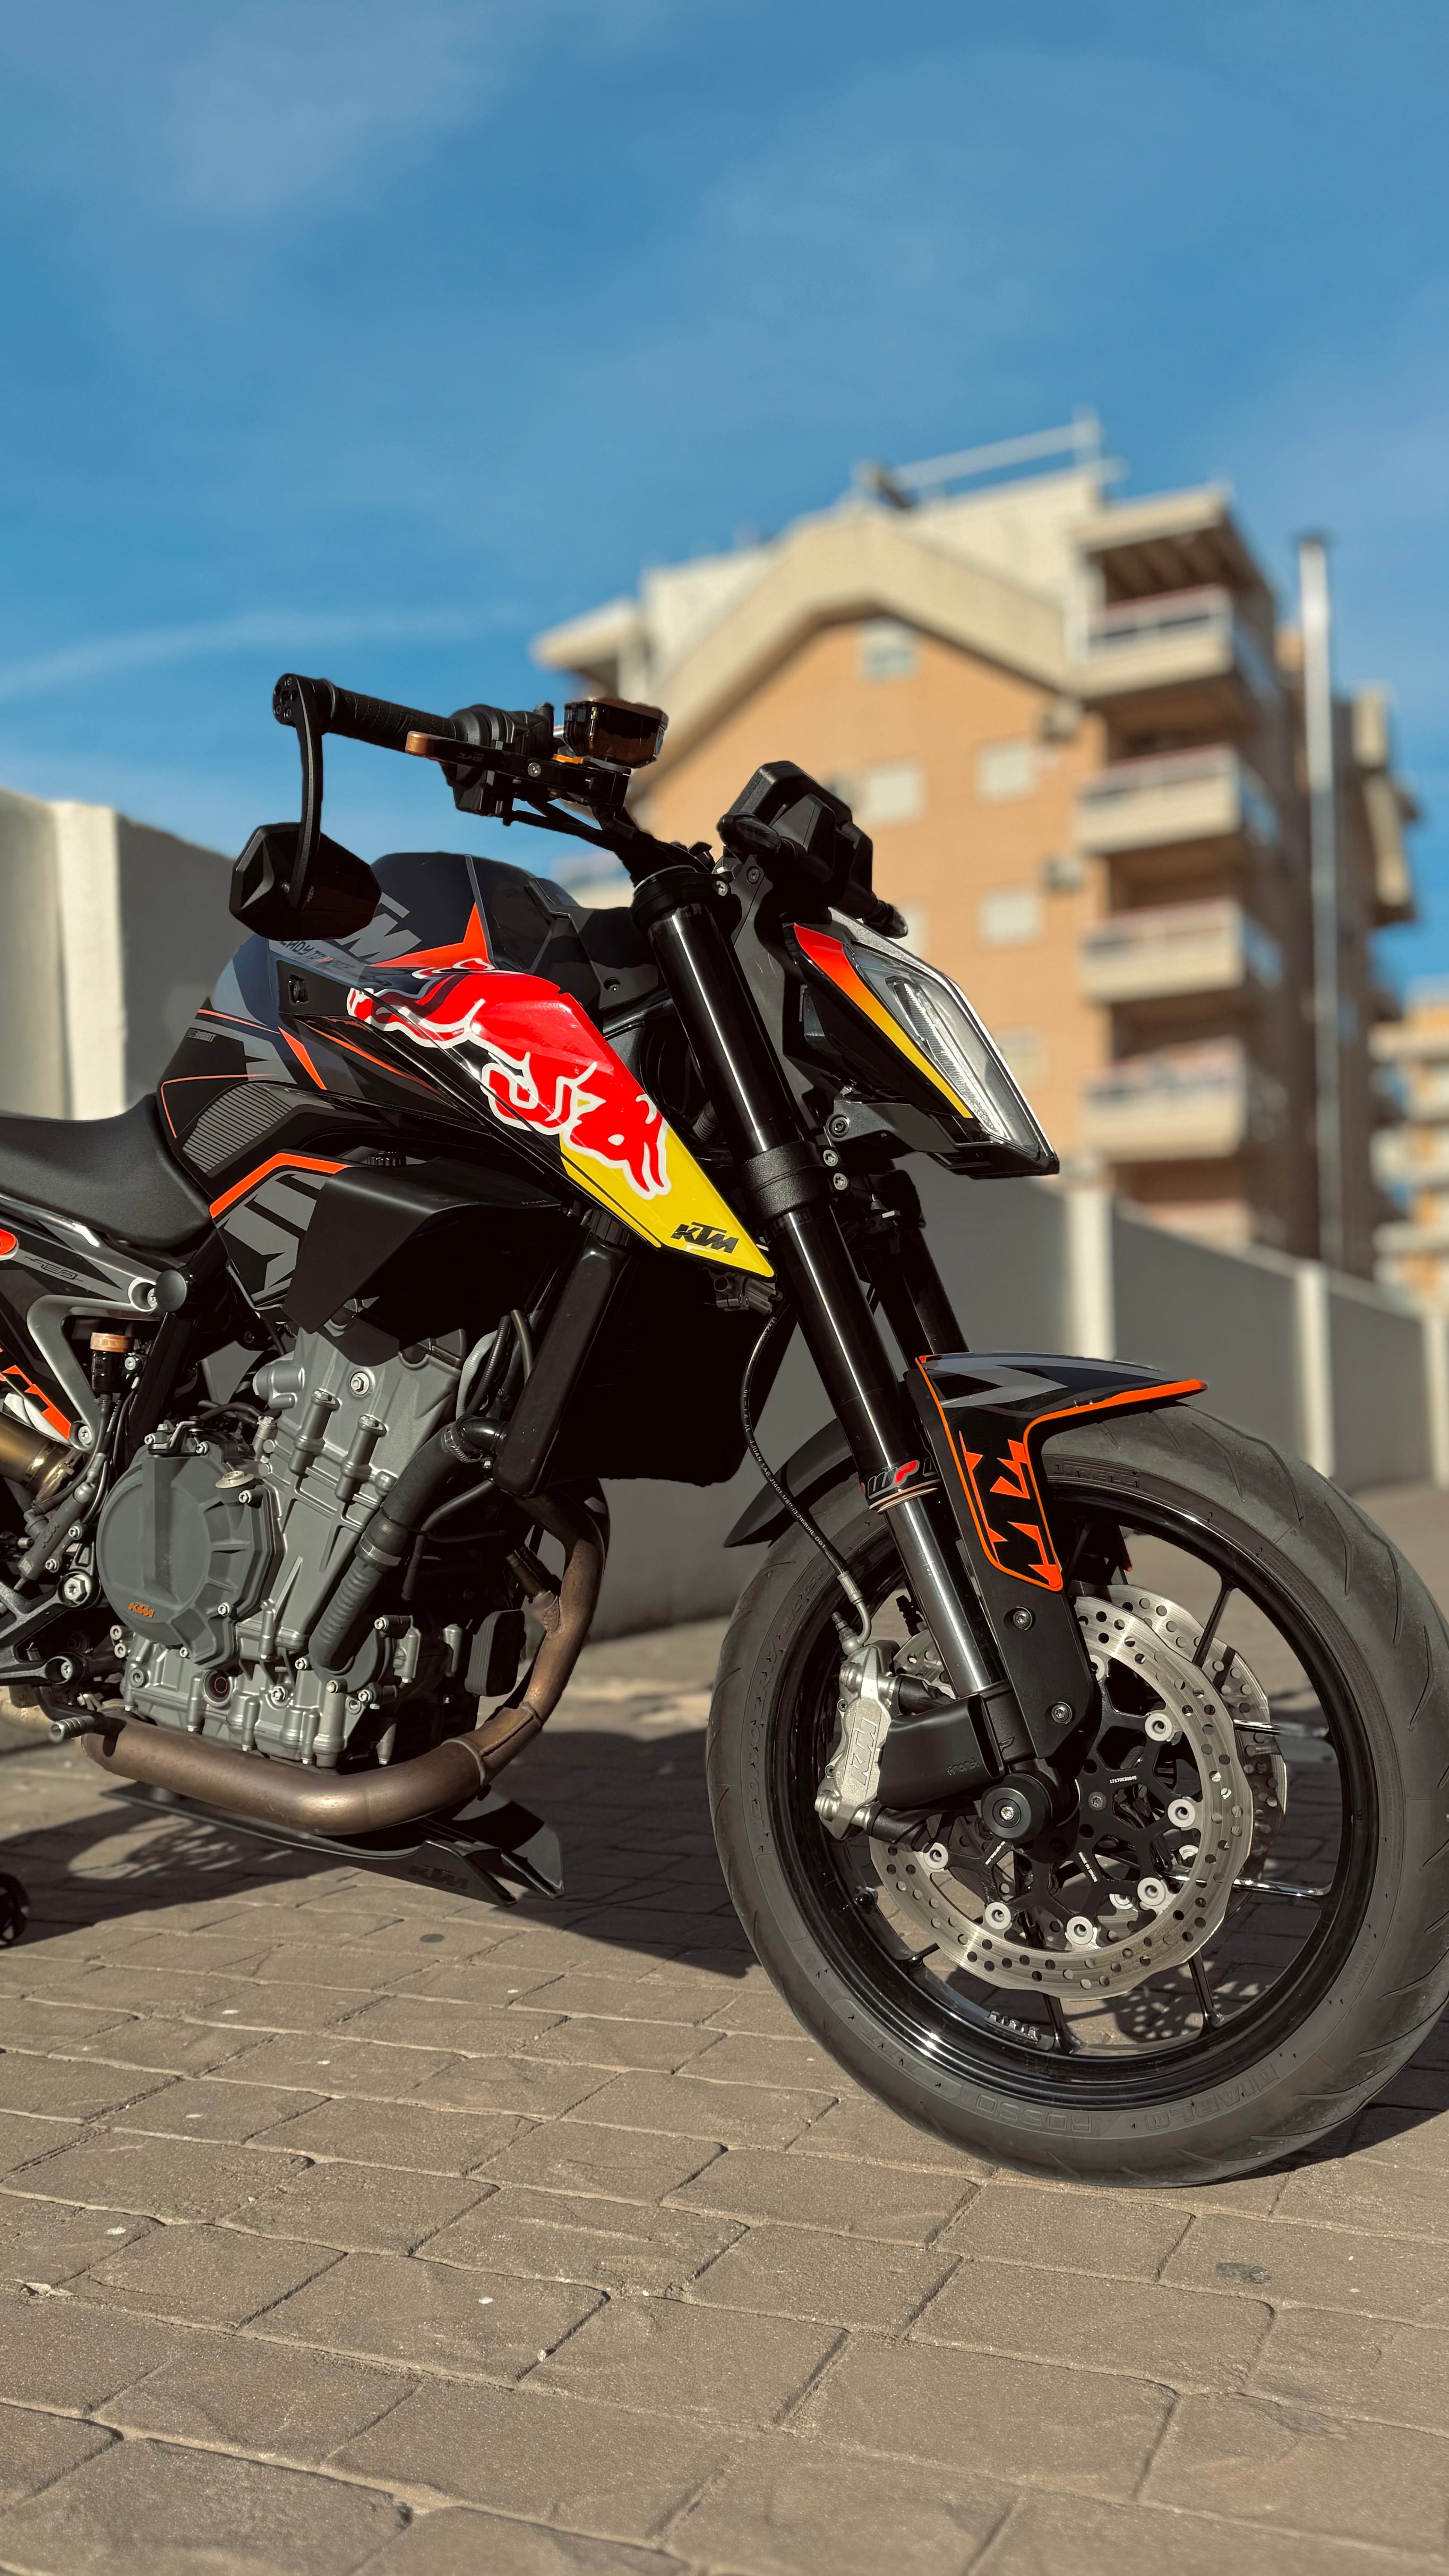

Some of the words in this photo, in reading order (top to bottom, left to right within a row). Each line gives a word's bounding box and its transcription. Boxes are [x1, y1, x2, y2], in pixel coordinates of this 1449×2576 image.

[280, 940, 314, 955] ADY
[671, 1222, 739, 1254] KTM
[760, 1463, 771, 1477] SAE
[128, 1603, 154, 1619] KTM
[851, 1717, 877, 1785] KTM
[408, 1864, 469, 1890] KTM
[976, 2094, 1092, 2133] ROSSO
